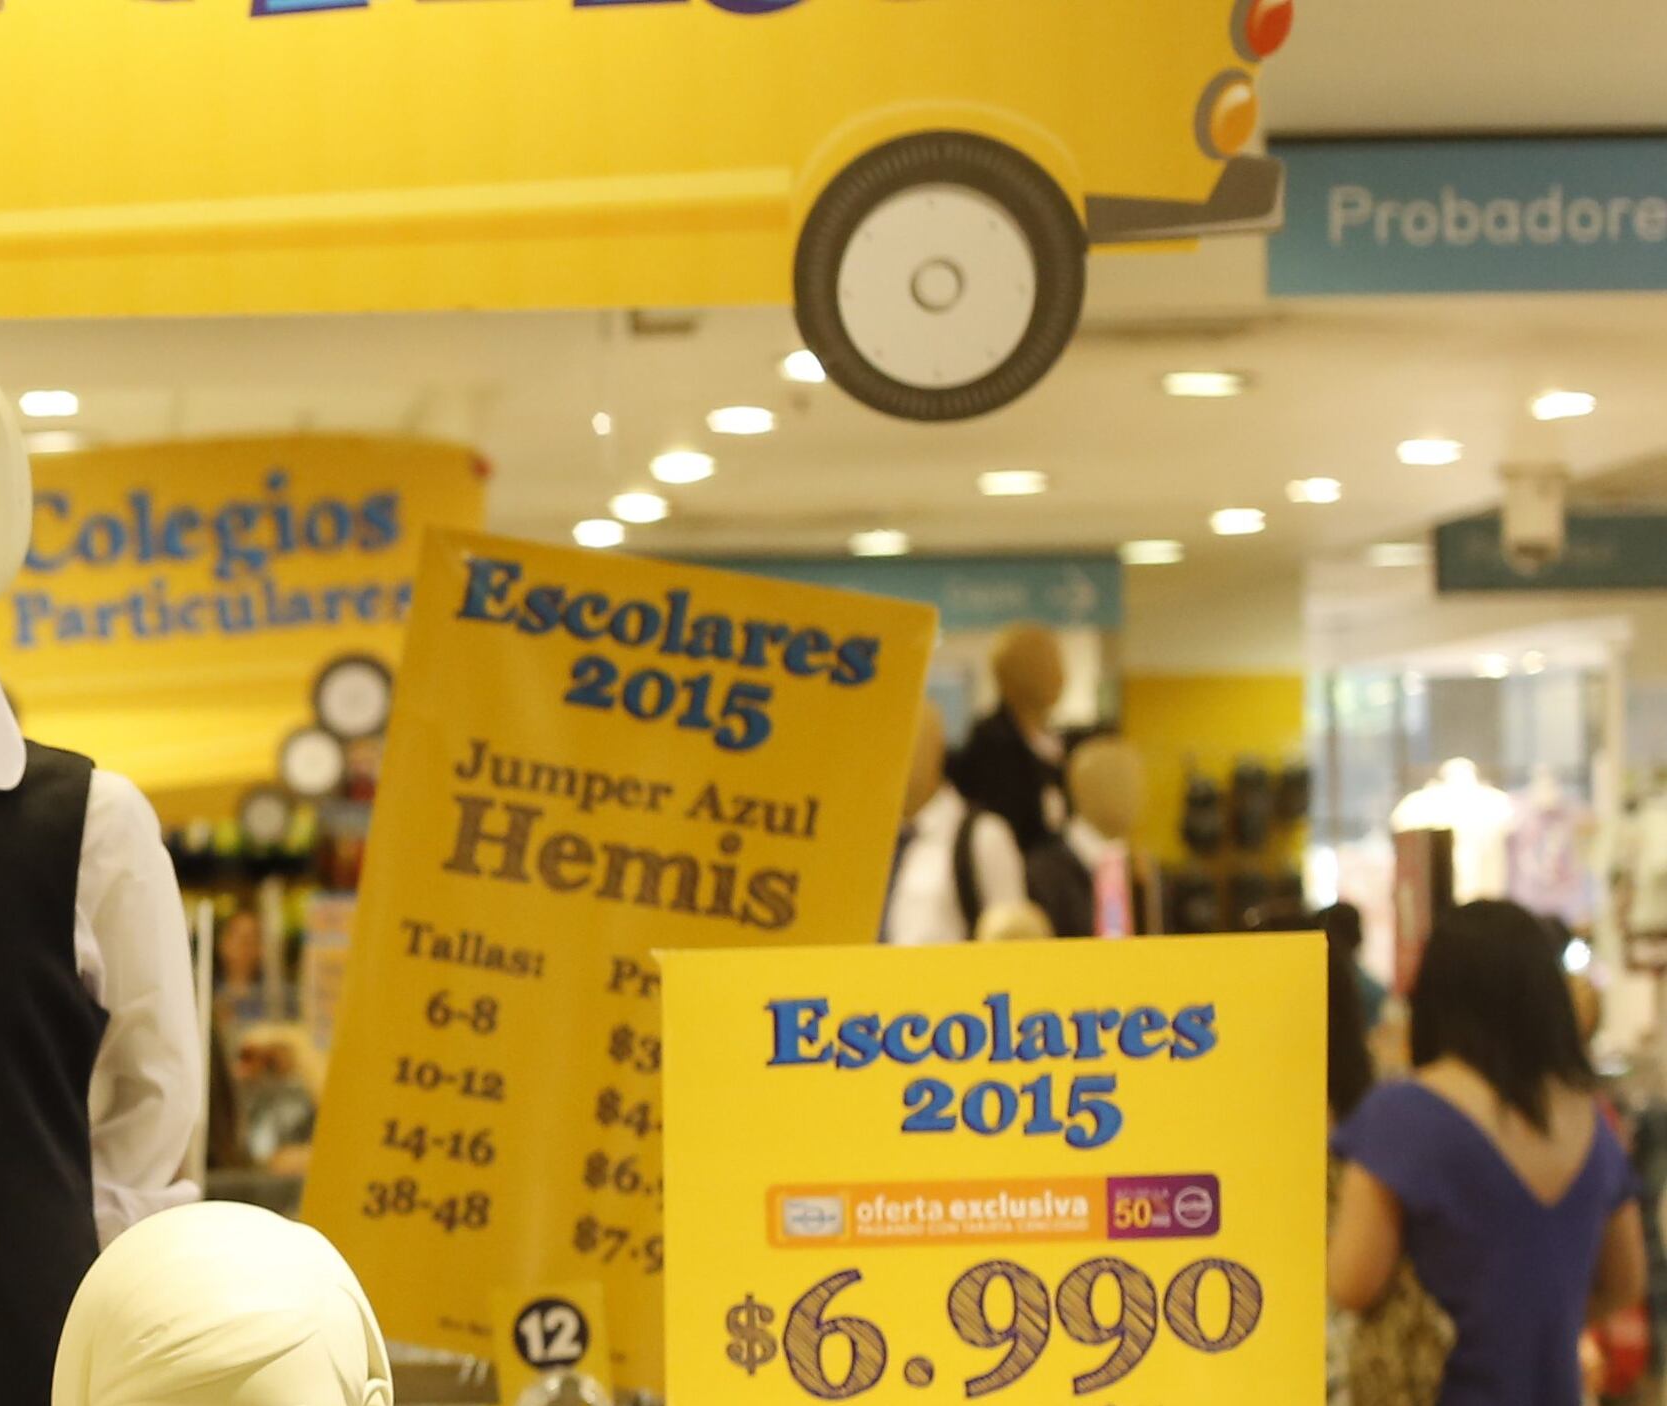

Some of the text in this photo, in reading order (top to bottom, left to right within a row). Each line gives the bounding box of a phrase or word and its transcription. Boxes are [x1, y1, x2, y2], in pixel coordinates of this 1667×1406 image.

[1327, 182, 1667, 247] Probadore
[23, 471, 402, 580] Colegios
[457, 557, 882, 686] Escolares
[565, 654, 773, 752] 2015
[454, 739, 819, 838] Jumper Azul
[443, 795, 800, 930] Hemis
[401, 919, 545, 979] Tallas:
[425, 990, 498, 1035] 6-8
[766, 992, 1217, 1069] Escolares
[395, 1056, 505, 1102] 10-12
[901, 1074, 1124, 1149] 2015
[381, 1119, 496, 1168] 14-16
[363, 1177, 492, 1234] 38-48
[856, 1195, 943, 1223] oferta
[949, 1191, 1089, 1221] exclusiva
[1114, 1197, 1152, 1230] 50
[519, 1306, 581, 1363] 12
[725, 1257, 1264, 1401] $6.990
